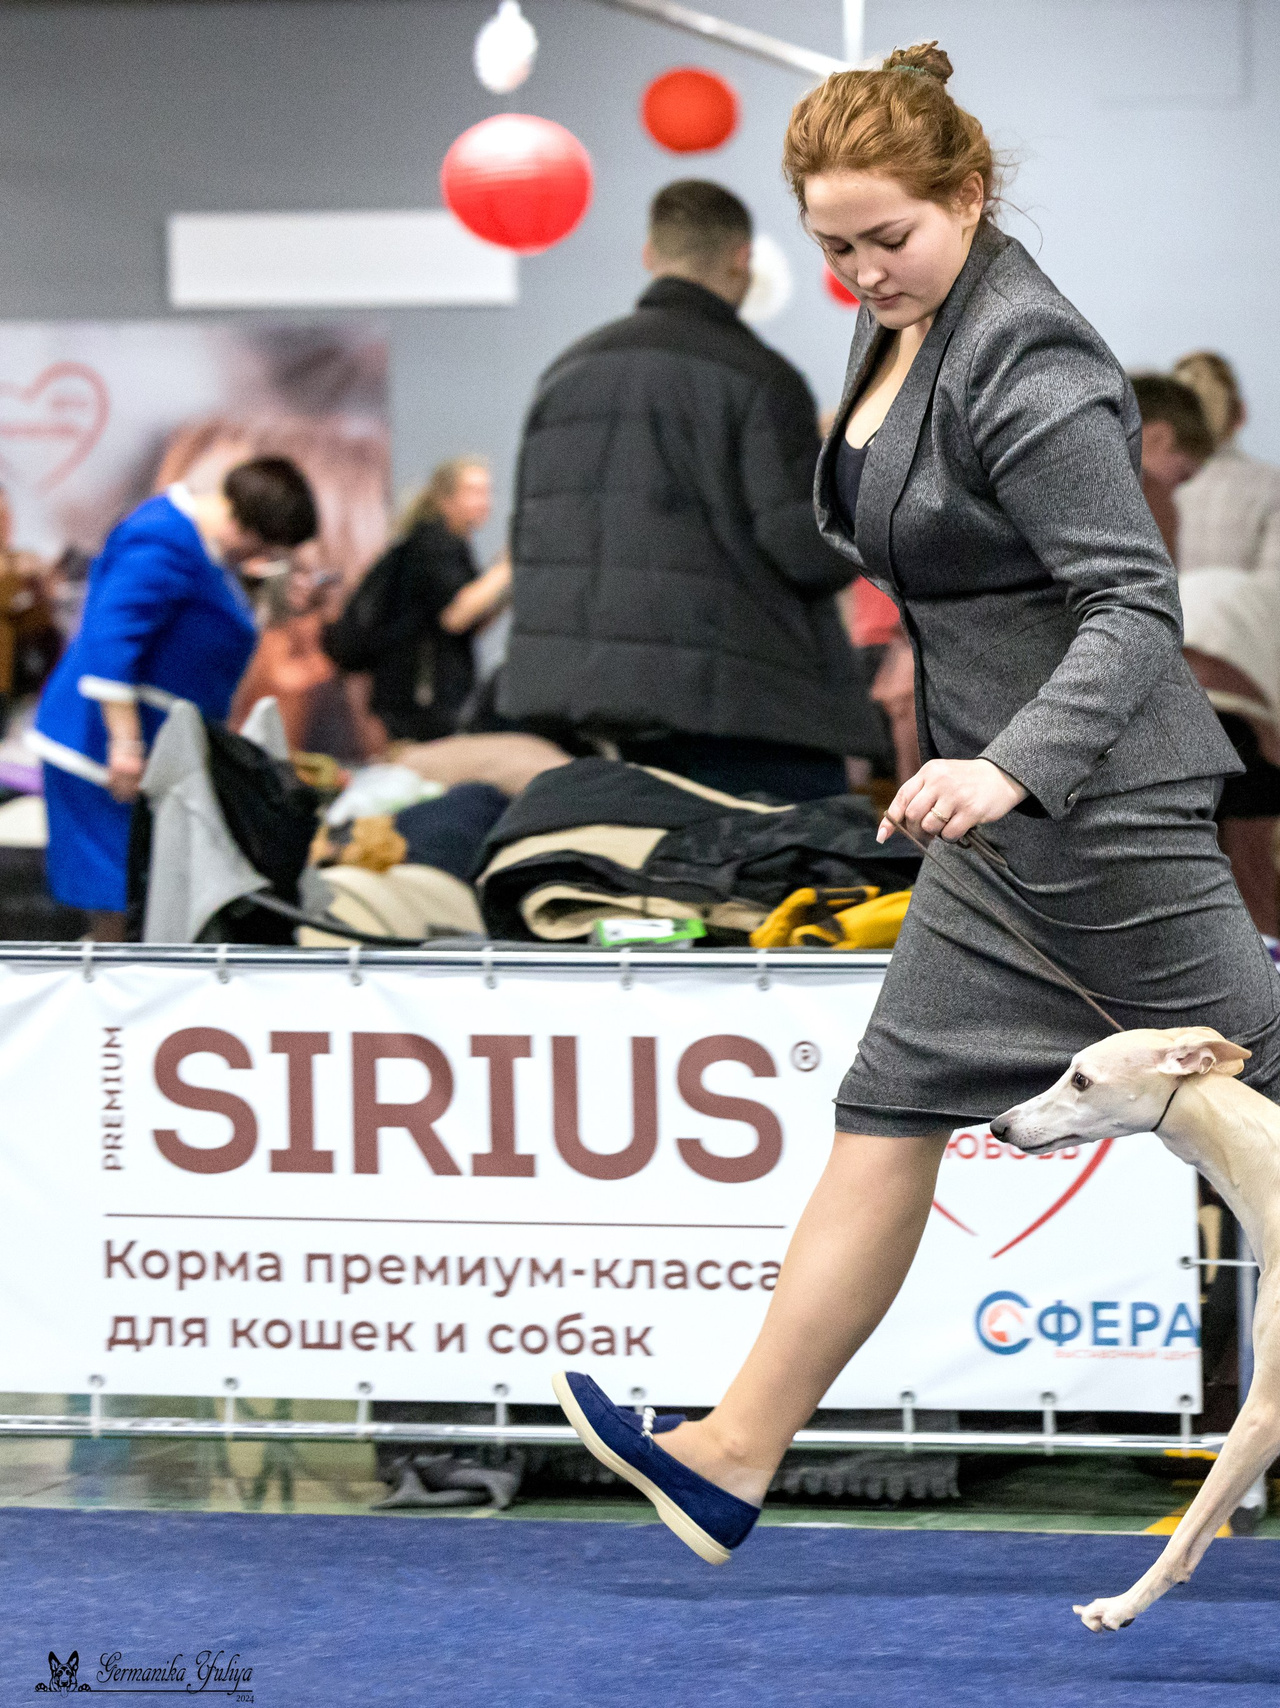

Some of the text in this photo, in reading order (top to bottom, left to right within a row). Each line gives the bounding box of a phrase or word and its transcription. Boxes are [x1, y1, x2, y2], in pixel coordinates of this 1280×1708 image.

[102, 1026, 124, 1171] PREMIUM
[105, 1239, 781, 1297] Корма премиум-класса
[106, 1312, 653, 1357] для кошек и собак
[975, 1289, 1201, 1356] СФЕРА
